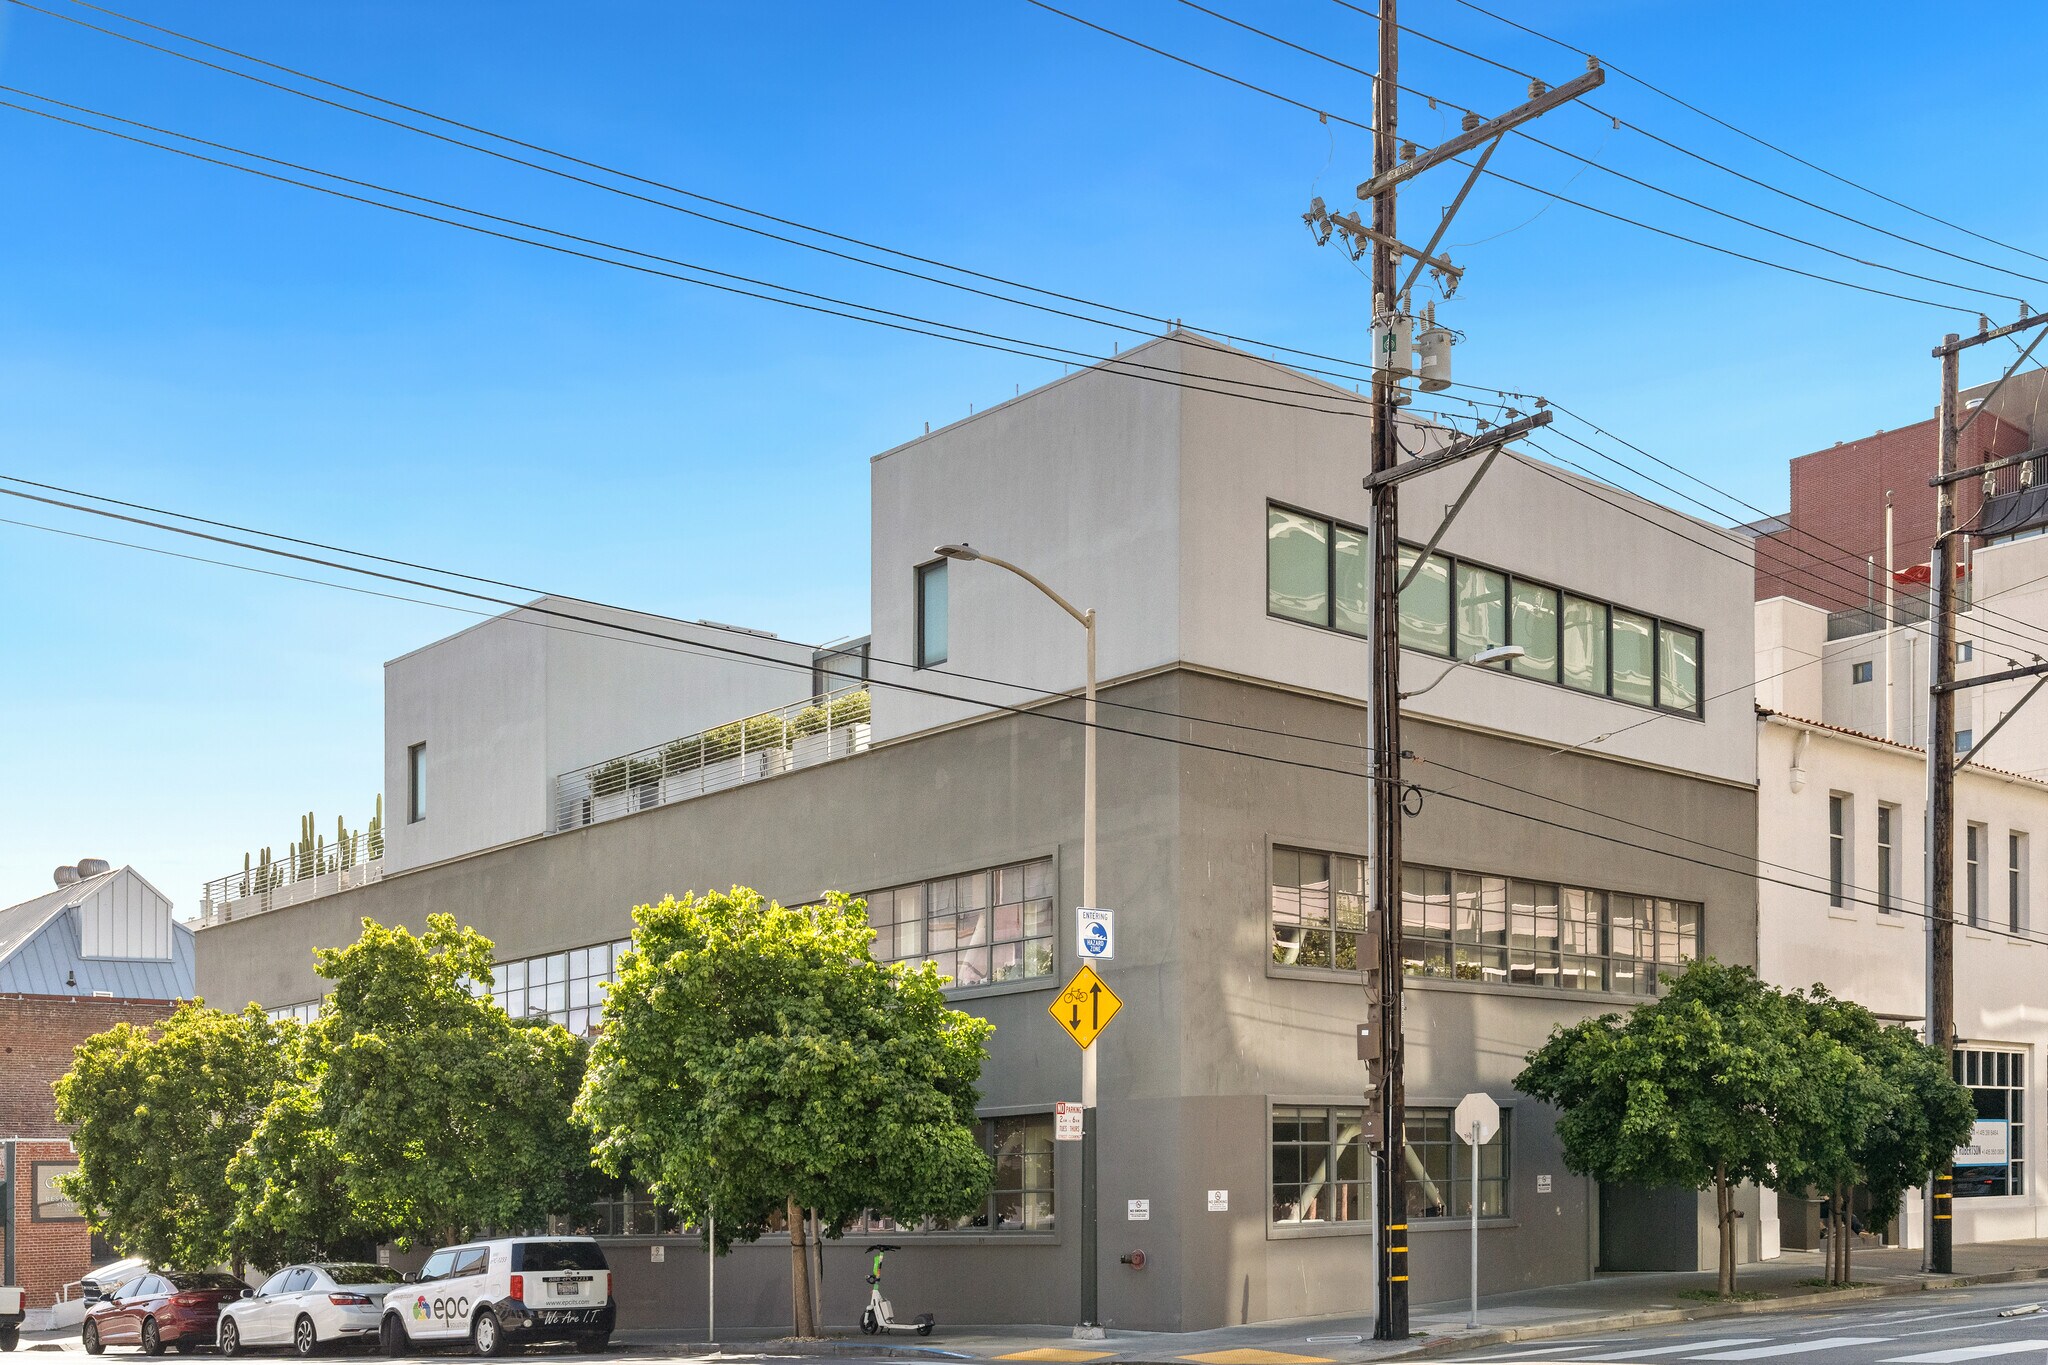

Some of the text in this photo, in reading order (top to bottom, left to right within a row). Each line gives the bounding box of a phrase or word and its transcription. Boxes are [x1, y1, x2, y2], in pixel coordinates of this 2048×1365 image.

[1083, 911, 1108, 920] ENTERING
[1058, 1104, 1065, 1113] NO
[433, 1296, 469, 1328] epc
[544, 1310, 559, 1325] We
[561, 1310, 580, 1324] Are
